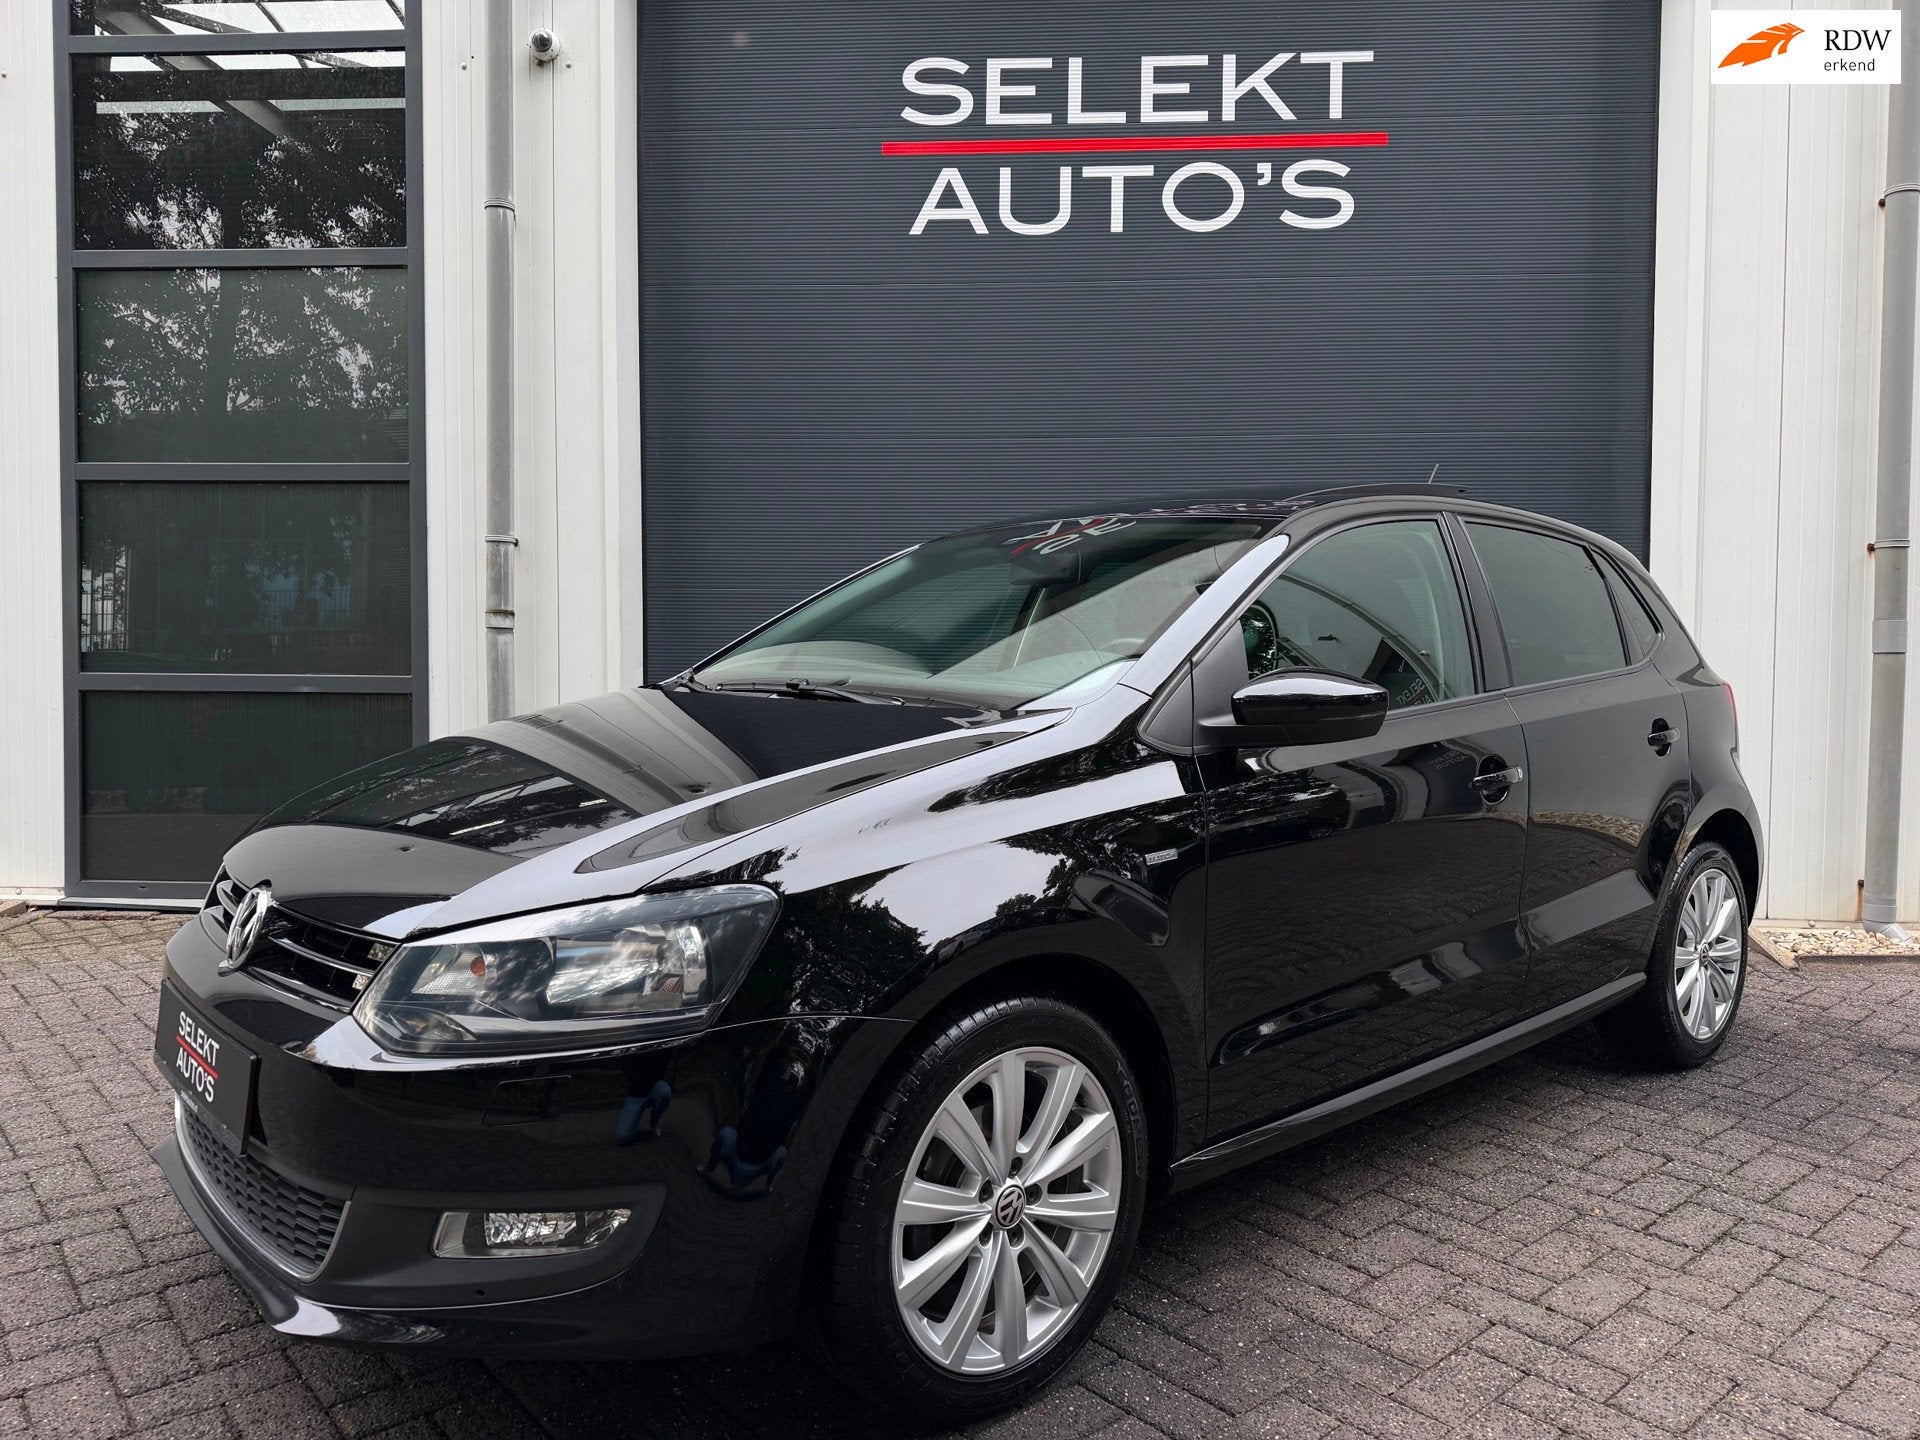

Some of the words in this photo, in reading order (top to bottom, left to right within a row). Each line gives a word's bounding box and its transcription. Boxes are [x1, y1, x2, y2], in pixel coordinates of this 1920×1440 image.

[900, 50, 1374, 126] SELEKT
[908, 158, 1355, 236] AUTO'S
[178, 1011, 220, 1067] SELEKT
[176, 1046, 215, 1102] AUTO'S
